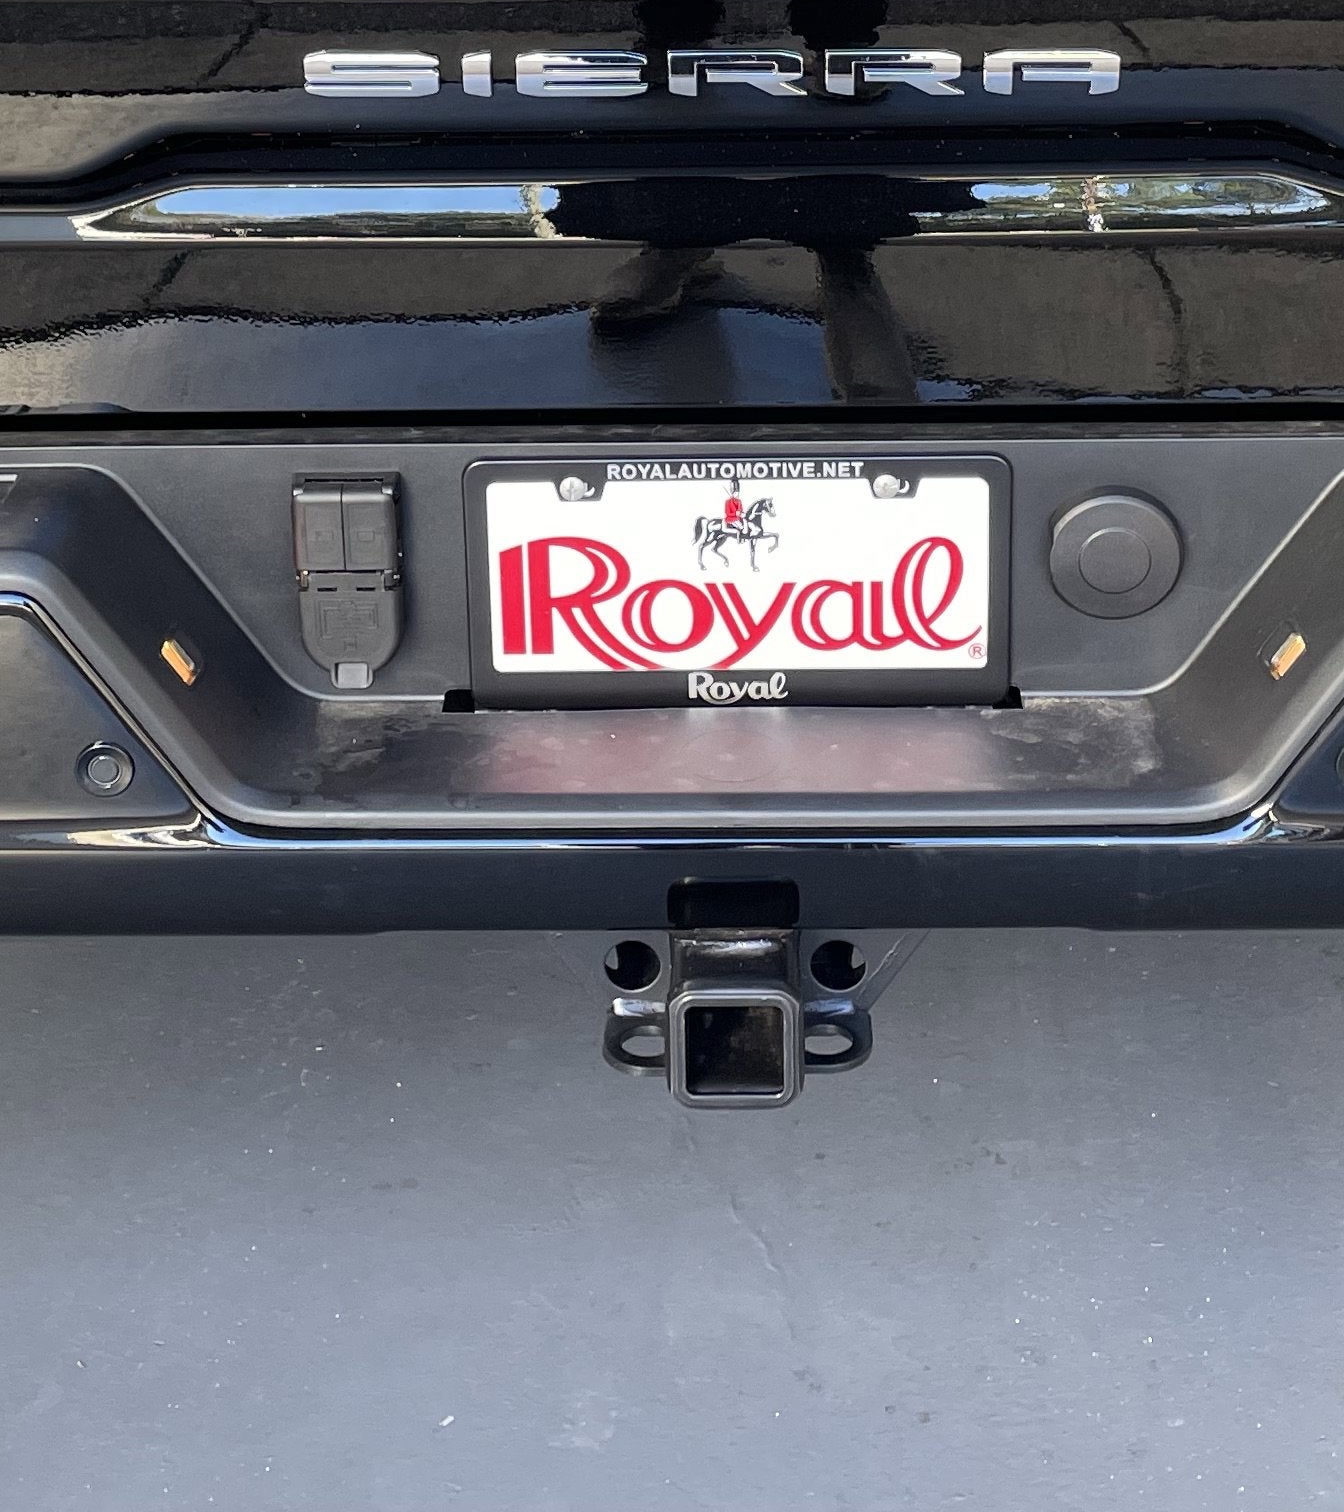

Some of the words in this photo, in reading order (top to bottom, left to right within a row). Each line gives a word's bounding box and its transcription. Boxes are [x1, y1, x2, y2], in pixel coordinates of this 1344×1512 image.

[302, 48, 1123, 99] SIERRA
[605, 461, 865, 481] ROYALAUTOMOTIVE.NET
[499, 536, 984, 671] Royal
[687, 670, 790, 705] Royal
